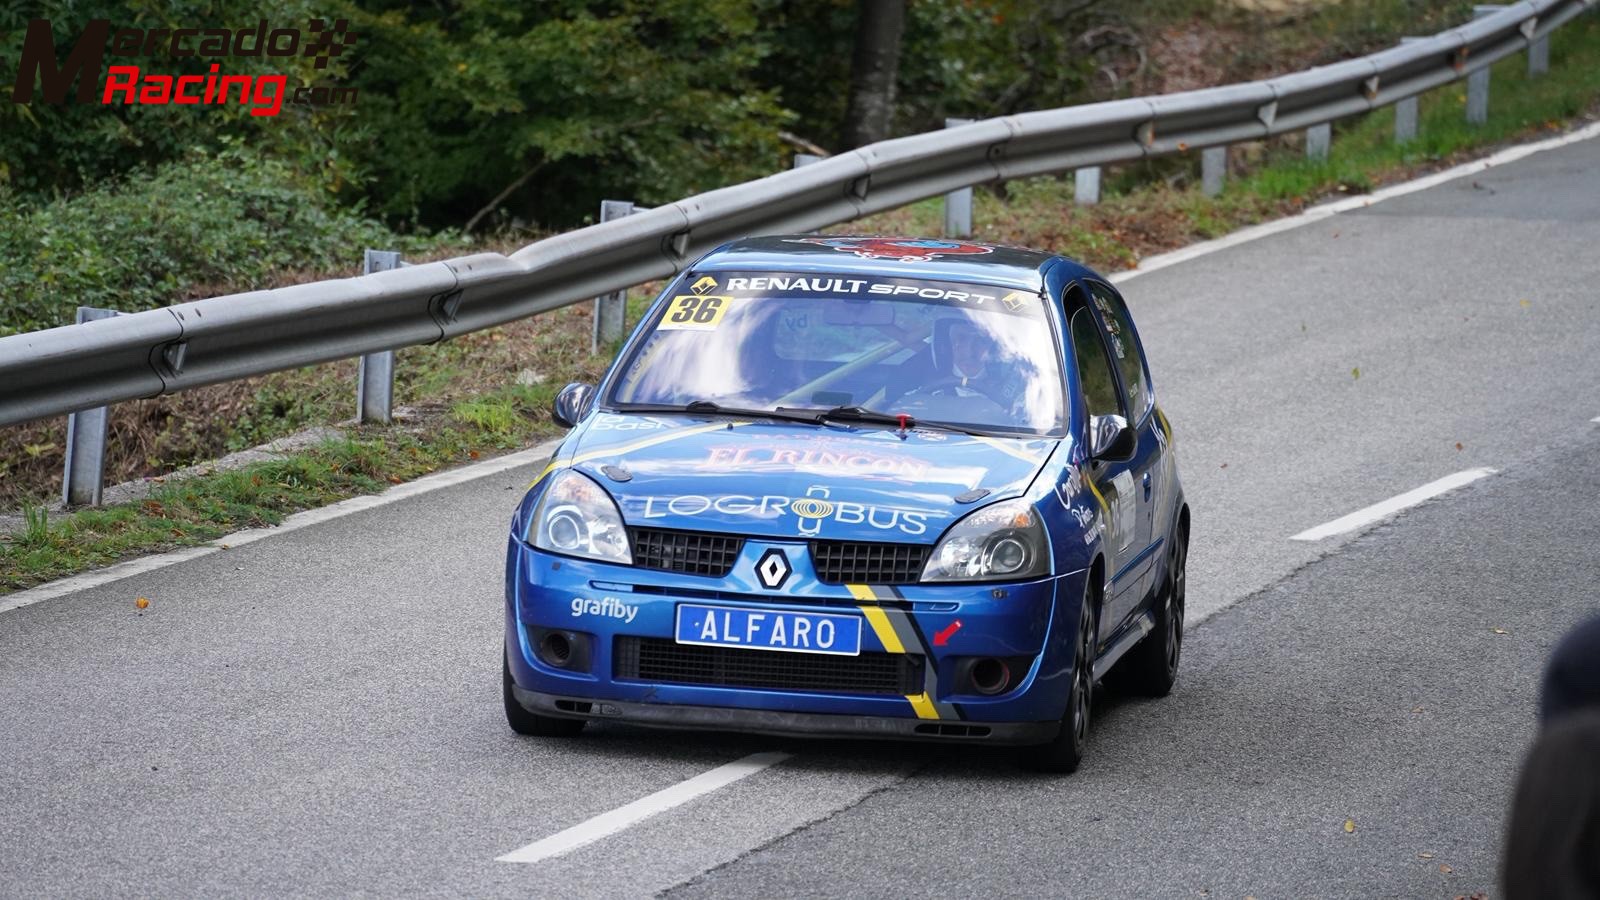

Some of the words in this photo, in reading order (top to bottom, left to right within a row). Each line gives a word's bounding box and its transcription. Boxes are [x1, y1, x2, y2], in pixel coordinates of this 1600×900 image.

[726, 276, 867, 294] RENAULT
[867, 283, 995, 305] SPORT
[671, 297, 722, 323] 36
[702, 446, 760, 467] EL
[643, 494, 928, 536] LOGROBUS
[571, 597, 639, 623] grafiby
[700, 610, 836, 649] ALFARO
